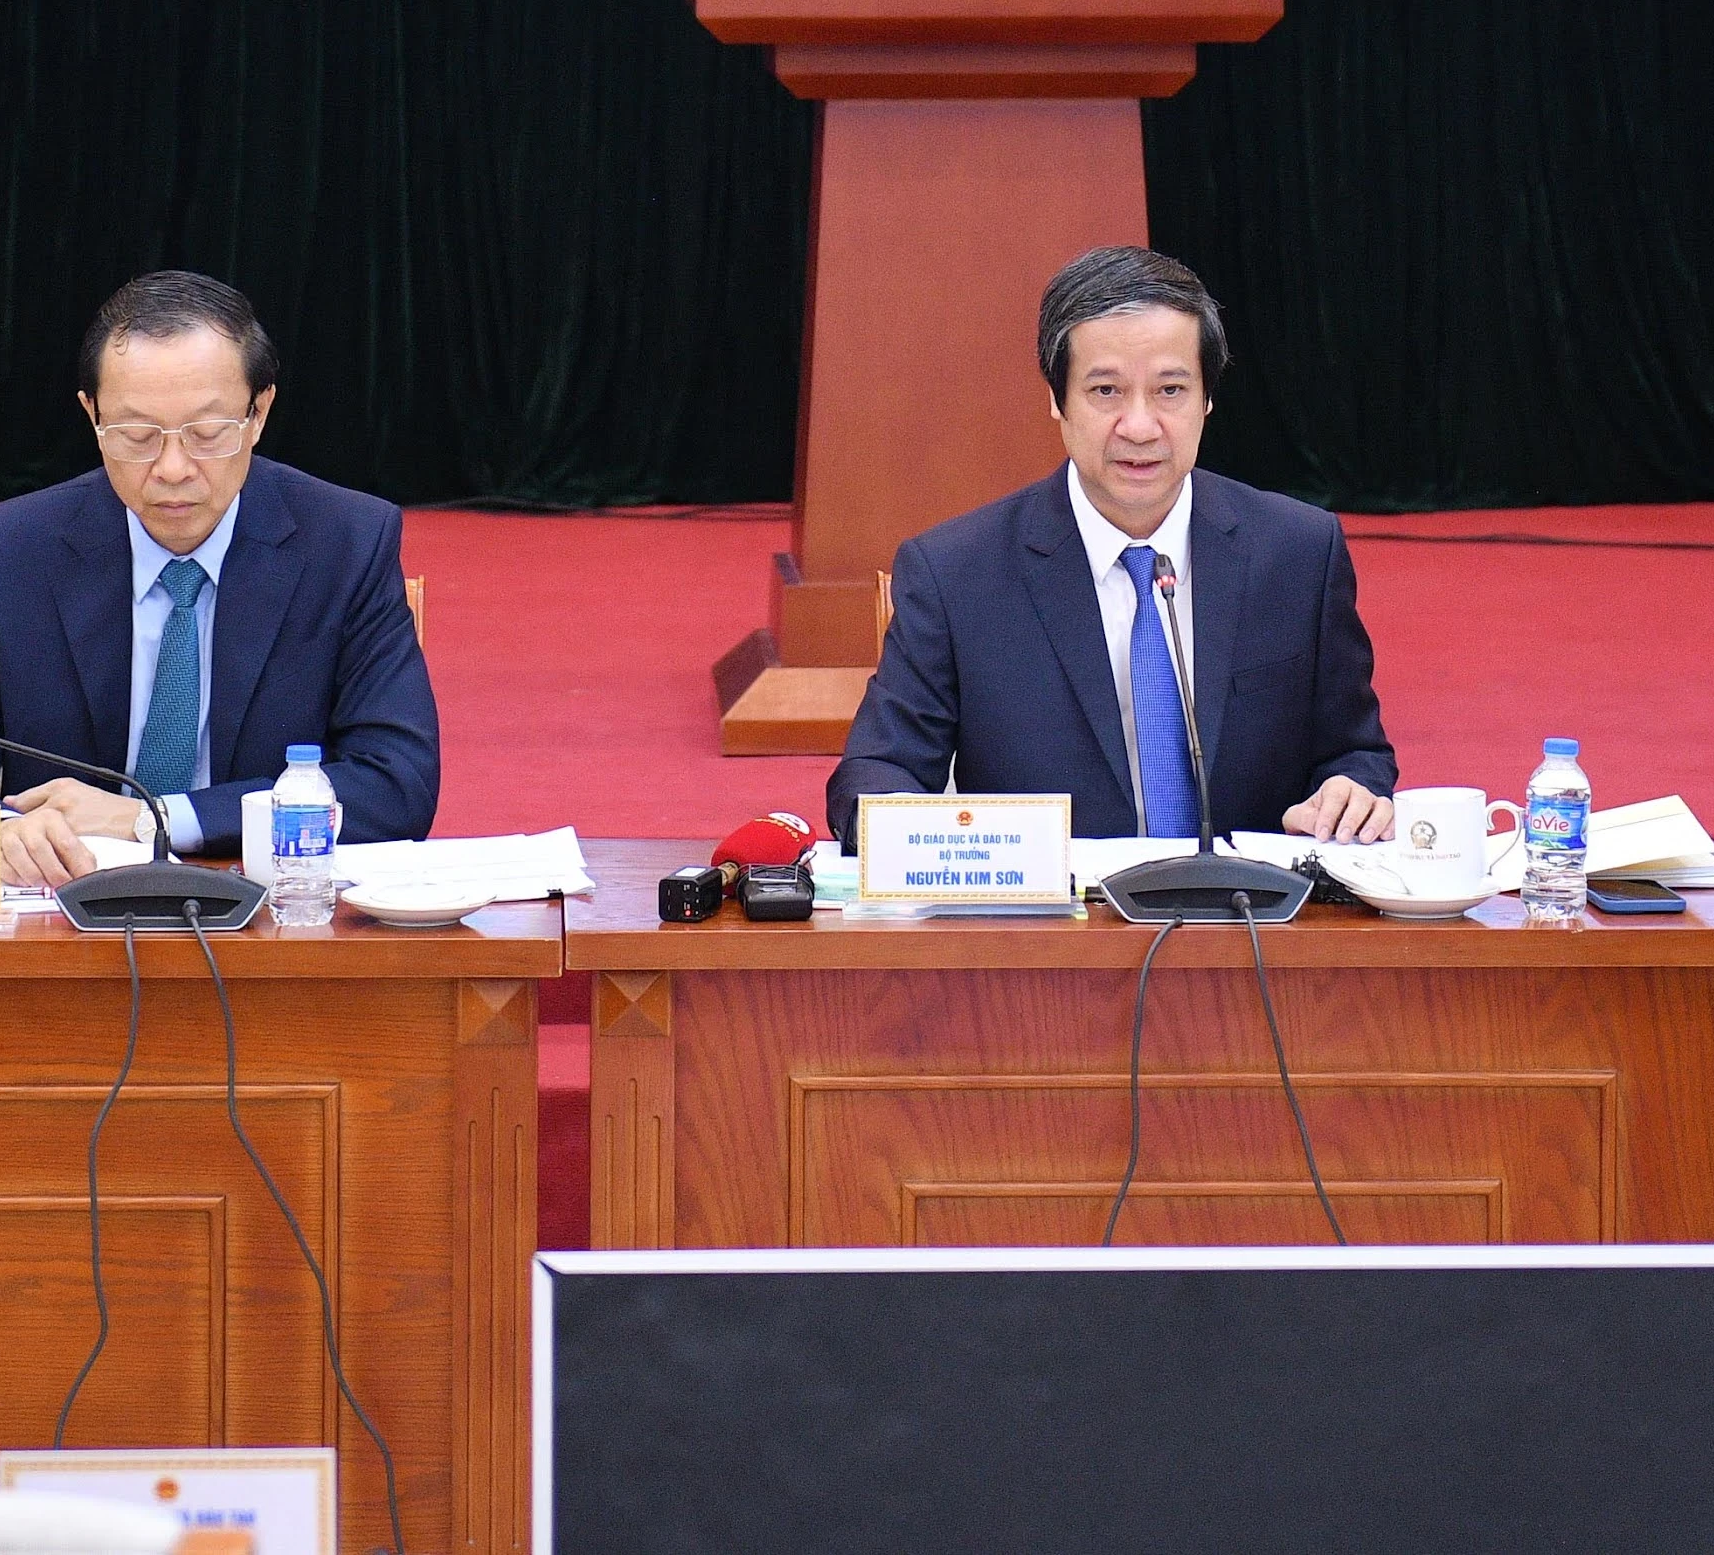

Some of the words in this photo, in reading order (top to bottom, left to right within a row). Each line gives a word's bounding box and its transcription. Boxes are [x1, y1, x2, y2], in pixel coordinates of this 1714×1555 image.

[909, 833, 920, 845] BỘ
[924, 833, 944, 843] GIÁO
[948, 835, 965, 845] DỤC
[969, 833, 980, 843] VÀ
[983, 833, 1001, 843] ĐÀO
[1004, 835, 1021, 845] TẠO
[940, 849, 951, 862] BỘ
[954, 847, 989, 860] TRƯỞNG
[906, 866, 960, 885] NGUYỄN
[965, 872, 991, 885] KIM
[996, 870, 1023, 885] SƠN
